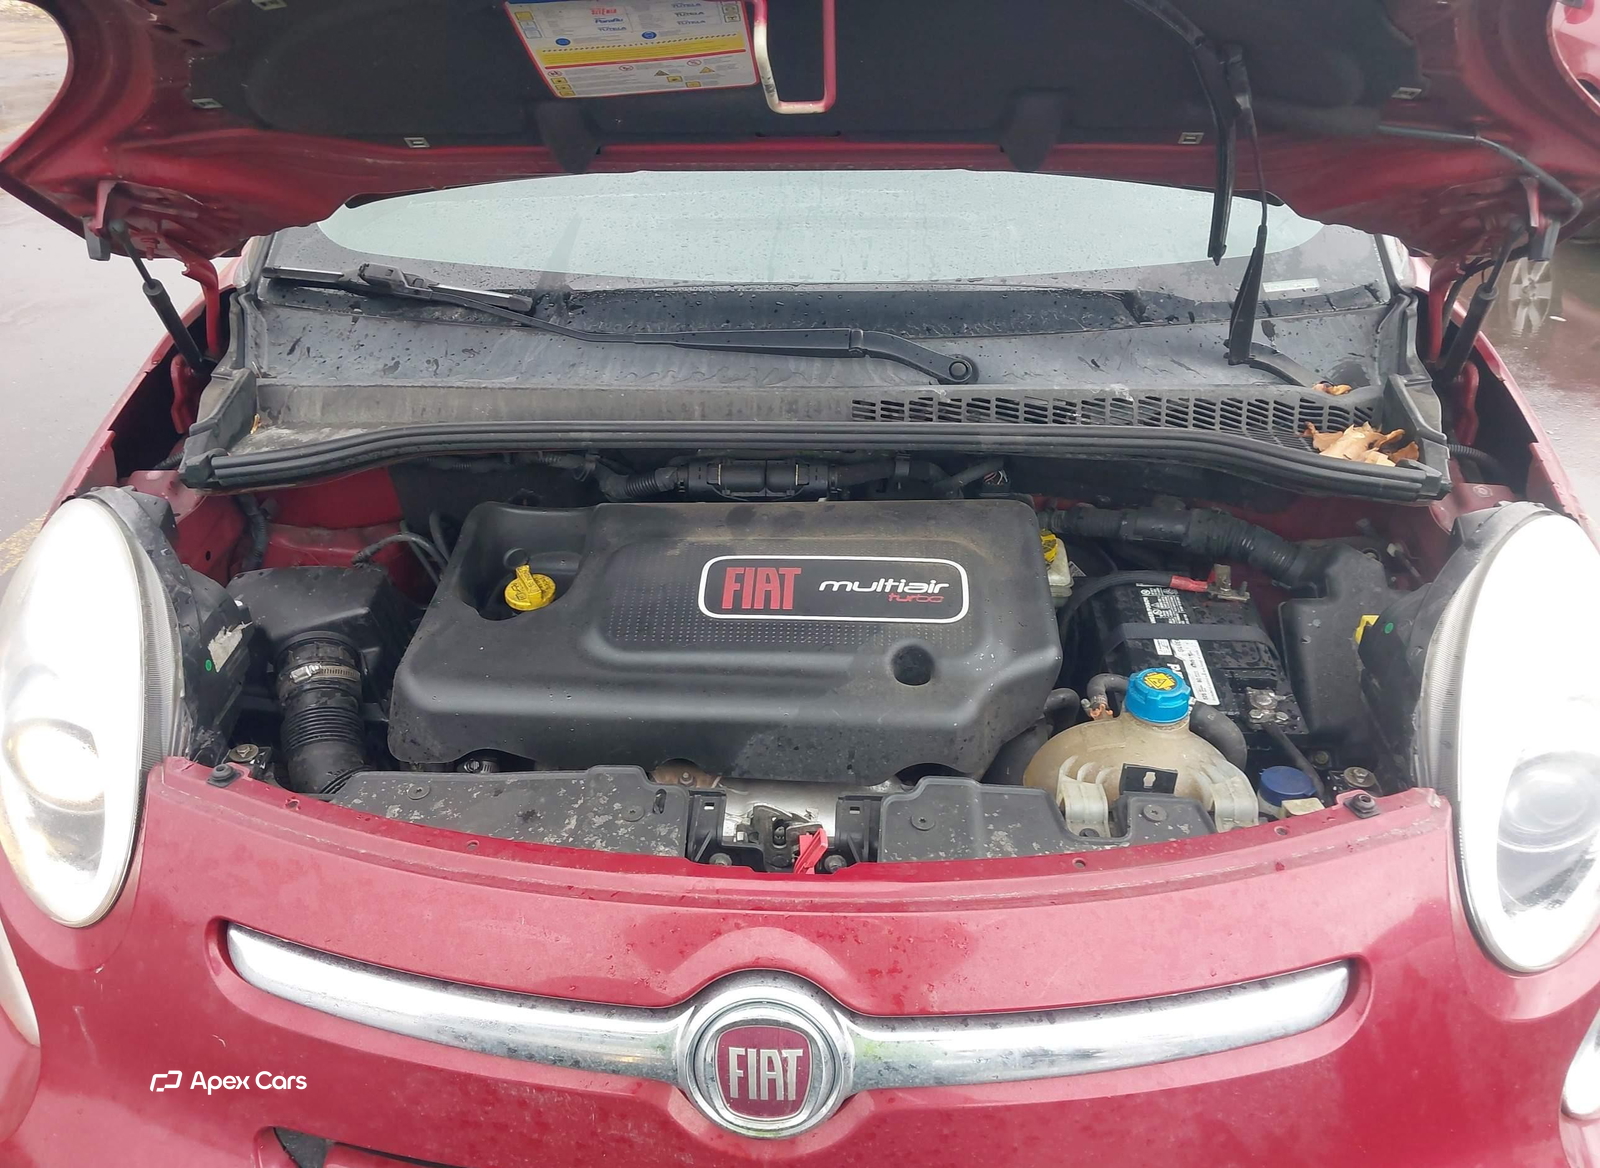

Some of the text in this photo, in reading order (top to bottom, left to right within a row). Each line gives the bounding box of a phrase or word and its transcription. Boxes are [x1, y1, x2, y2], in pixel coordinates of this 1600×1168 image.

[721, 567, 950, 609] FIAT multiair
[888, 592, 945, 603] turbo
[728, 1046, 804, 1101] FIAT
